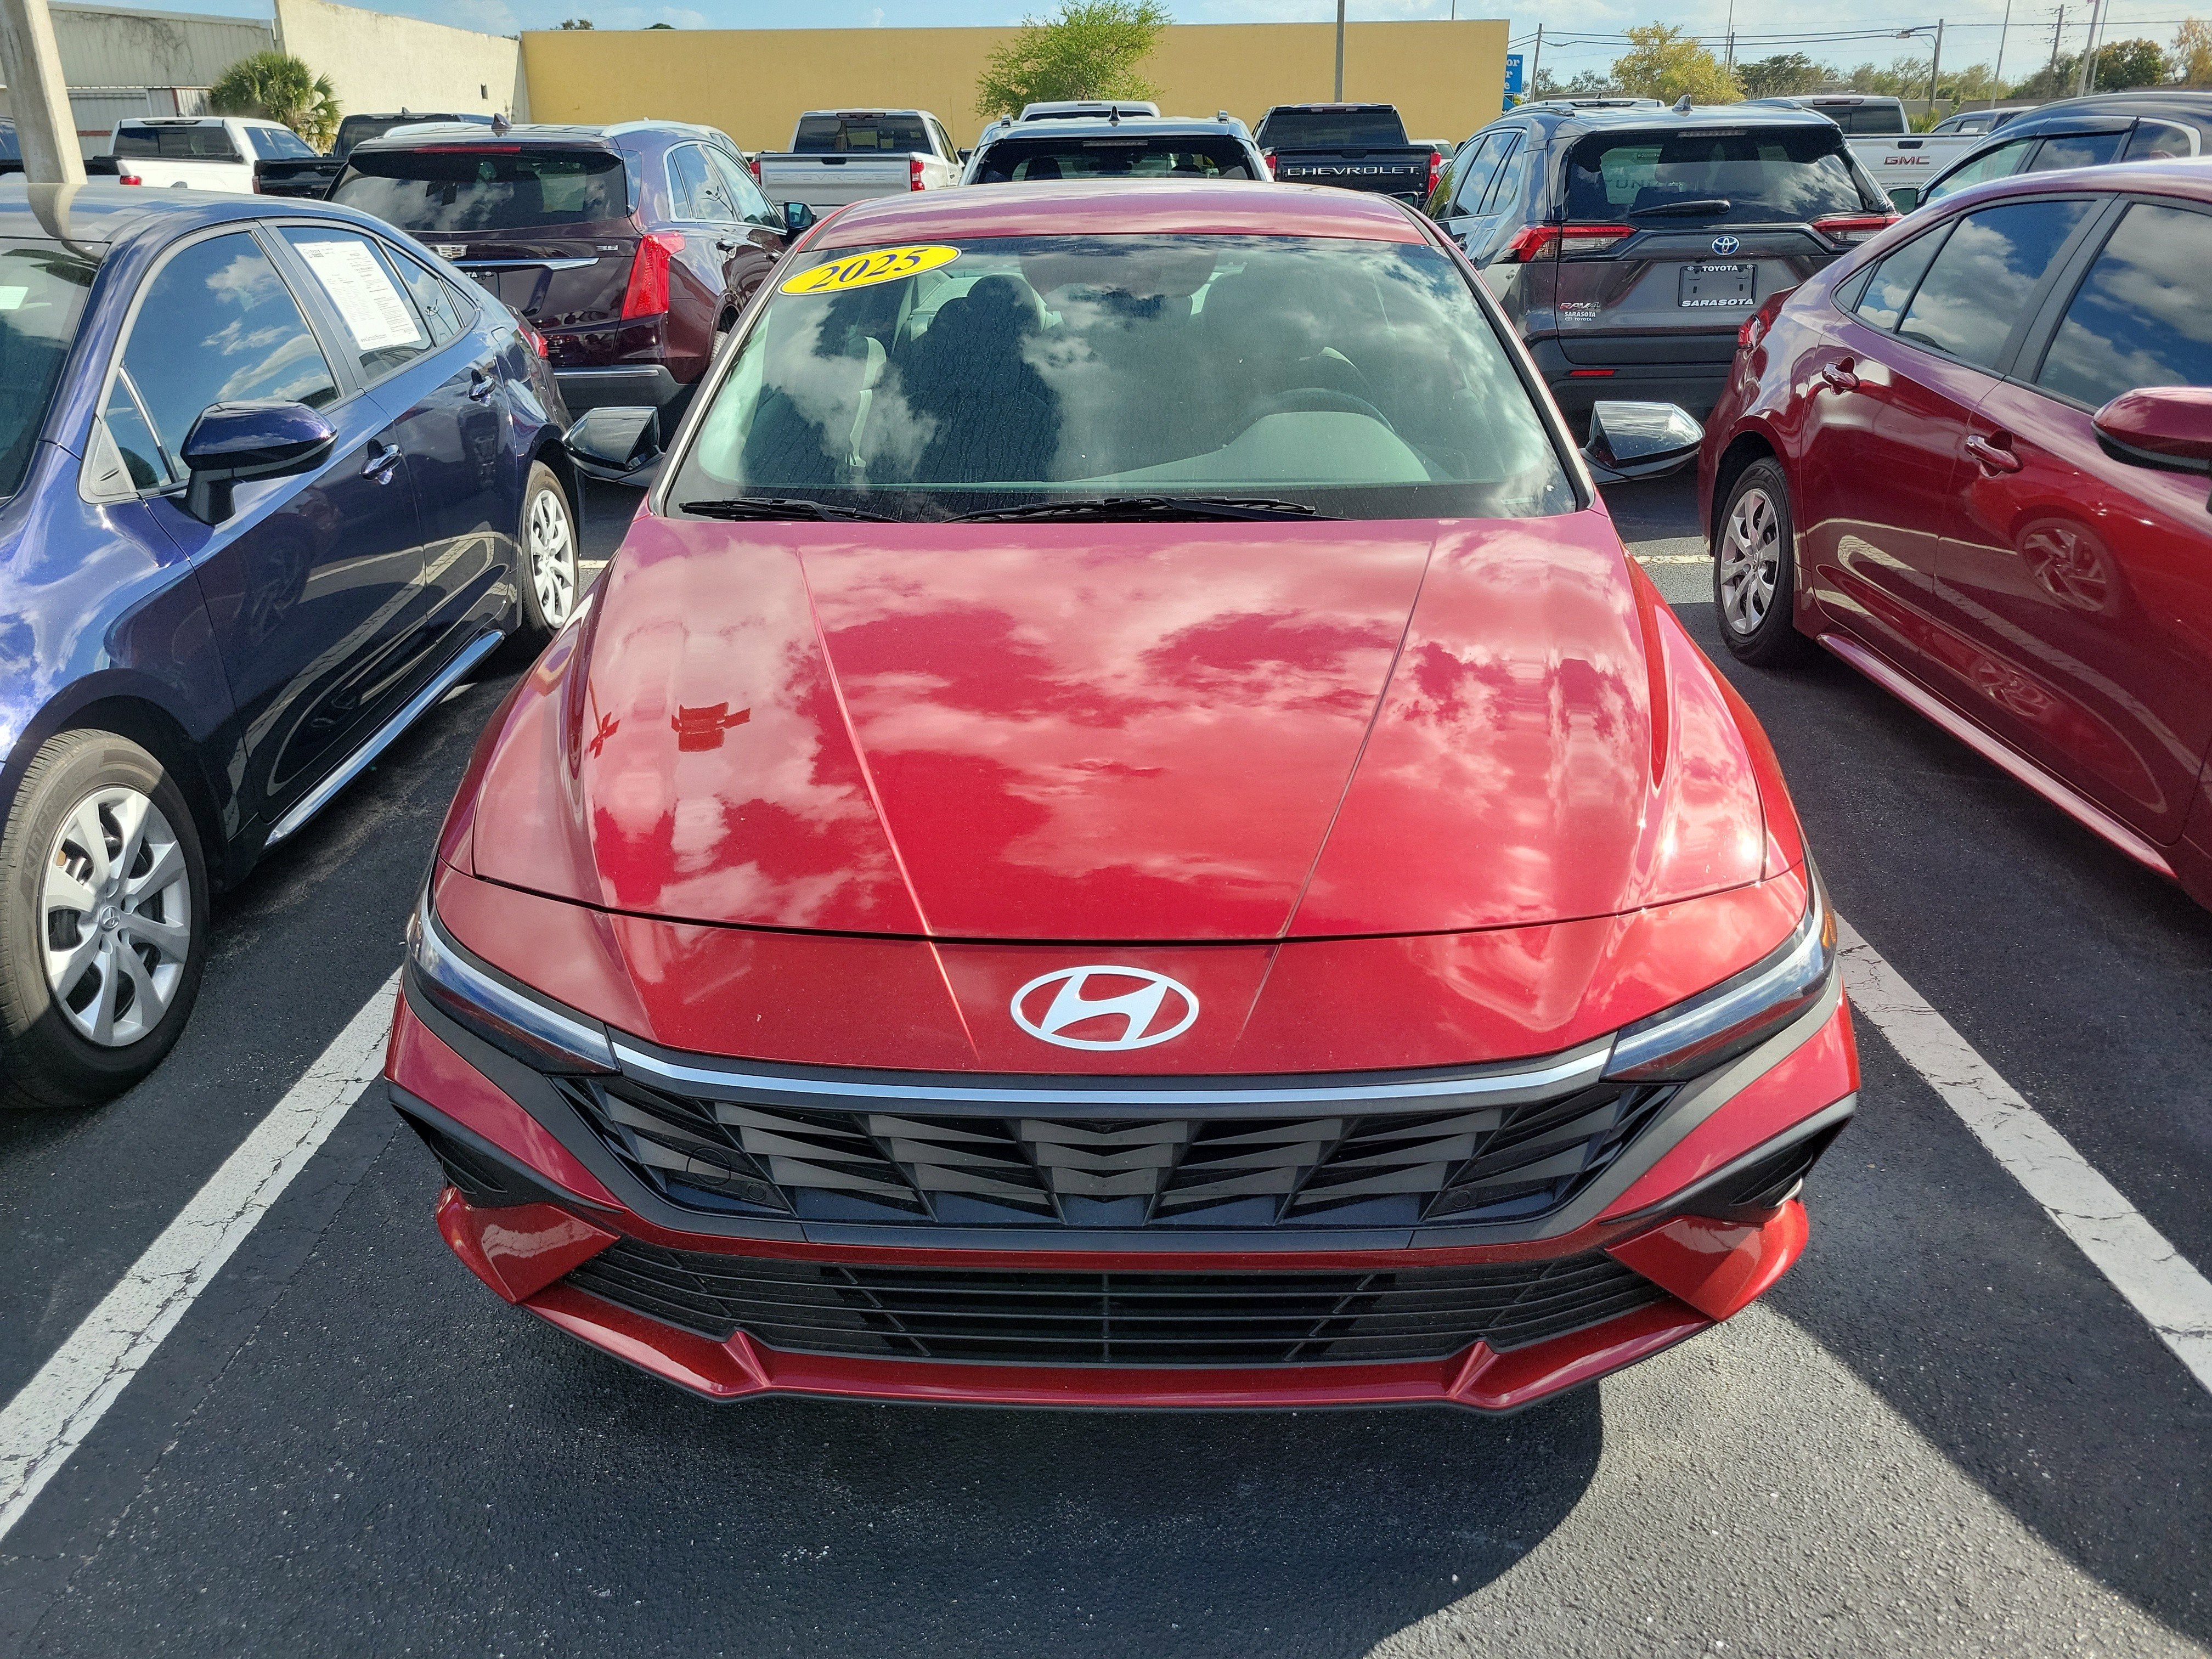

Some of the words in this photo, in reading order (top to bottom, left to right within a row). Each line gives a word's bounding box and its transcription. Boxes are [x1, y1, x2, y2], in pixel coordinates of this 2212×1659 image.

[1883, 156, 1931, 165] GMC
[1288, 166, 1419, 176] CHEVROLET
[770, 173, 900, 182] CHEVROLET
[805, 249, 930, 291] 2025
[1681, 298, 1753, 307] SARASOTA
